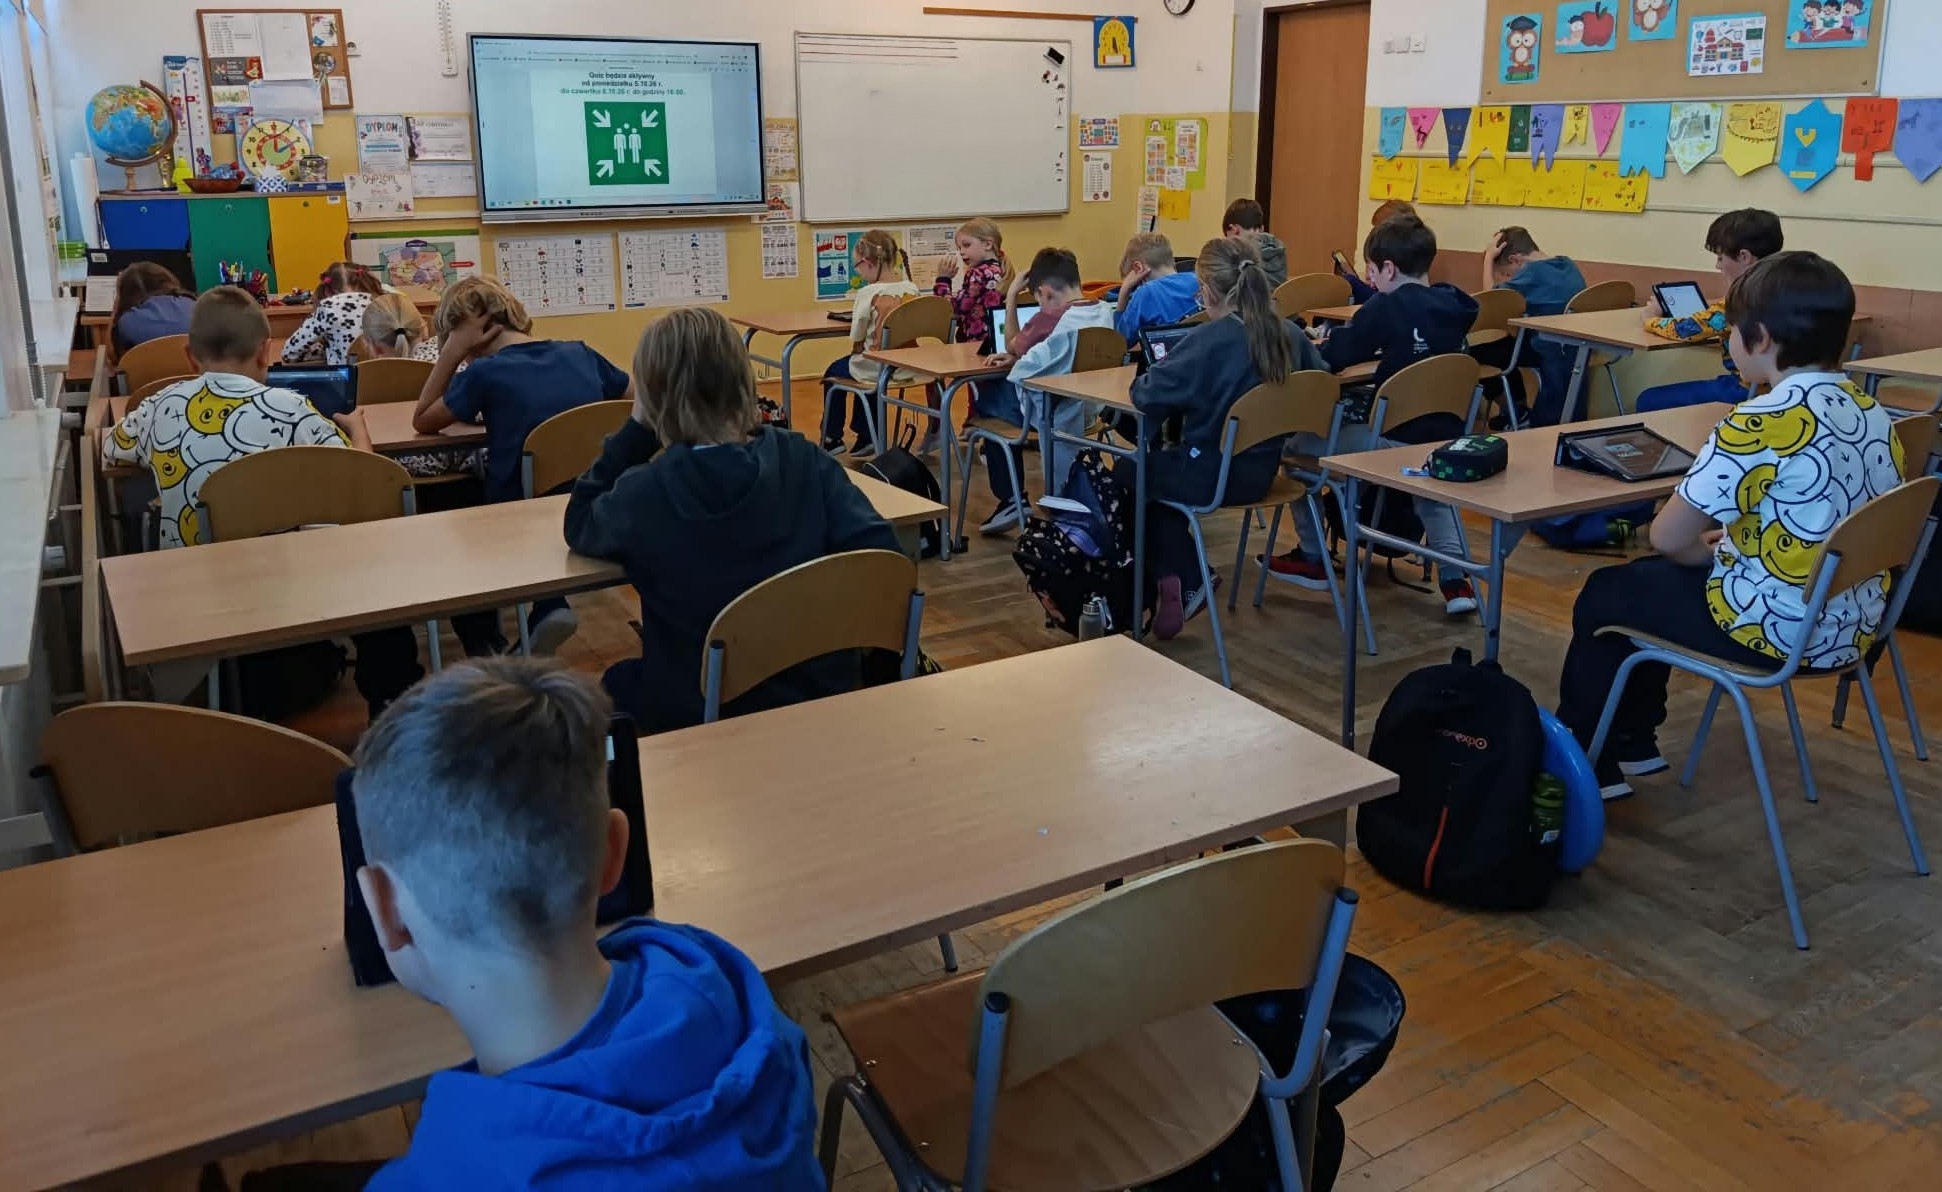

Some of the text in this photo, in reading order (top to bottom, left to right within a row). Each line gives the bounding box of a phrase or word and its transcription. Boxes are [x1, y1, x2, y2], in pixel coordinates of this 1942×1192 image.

[588, 71, 604, 79] Quiz
[628, 72, 655, 80] aktywny
[365, 120, 398, 133] DYPLOM
